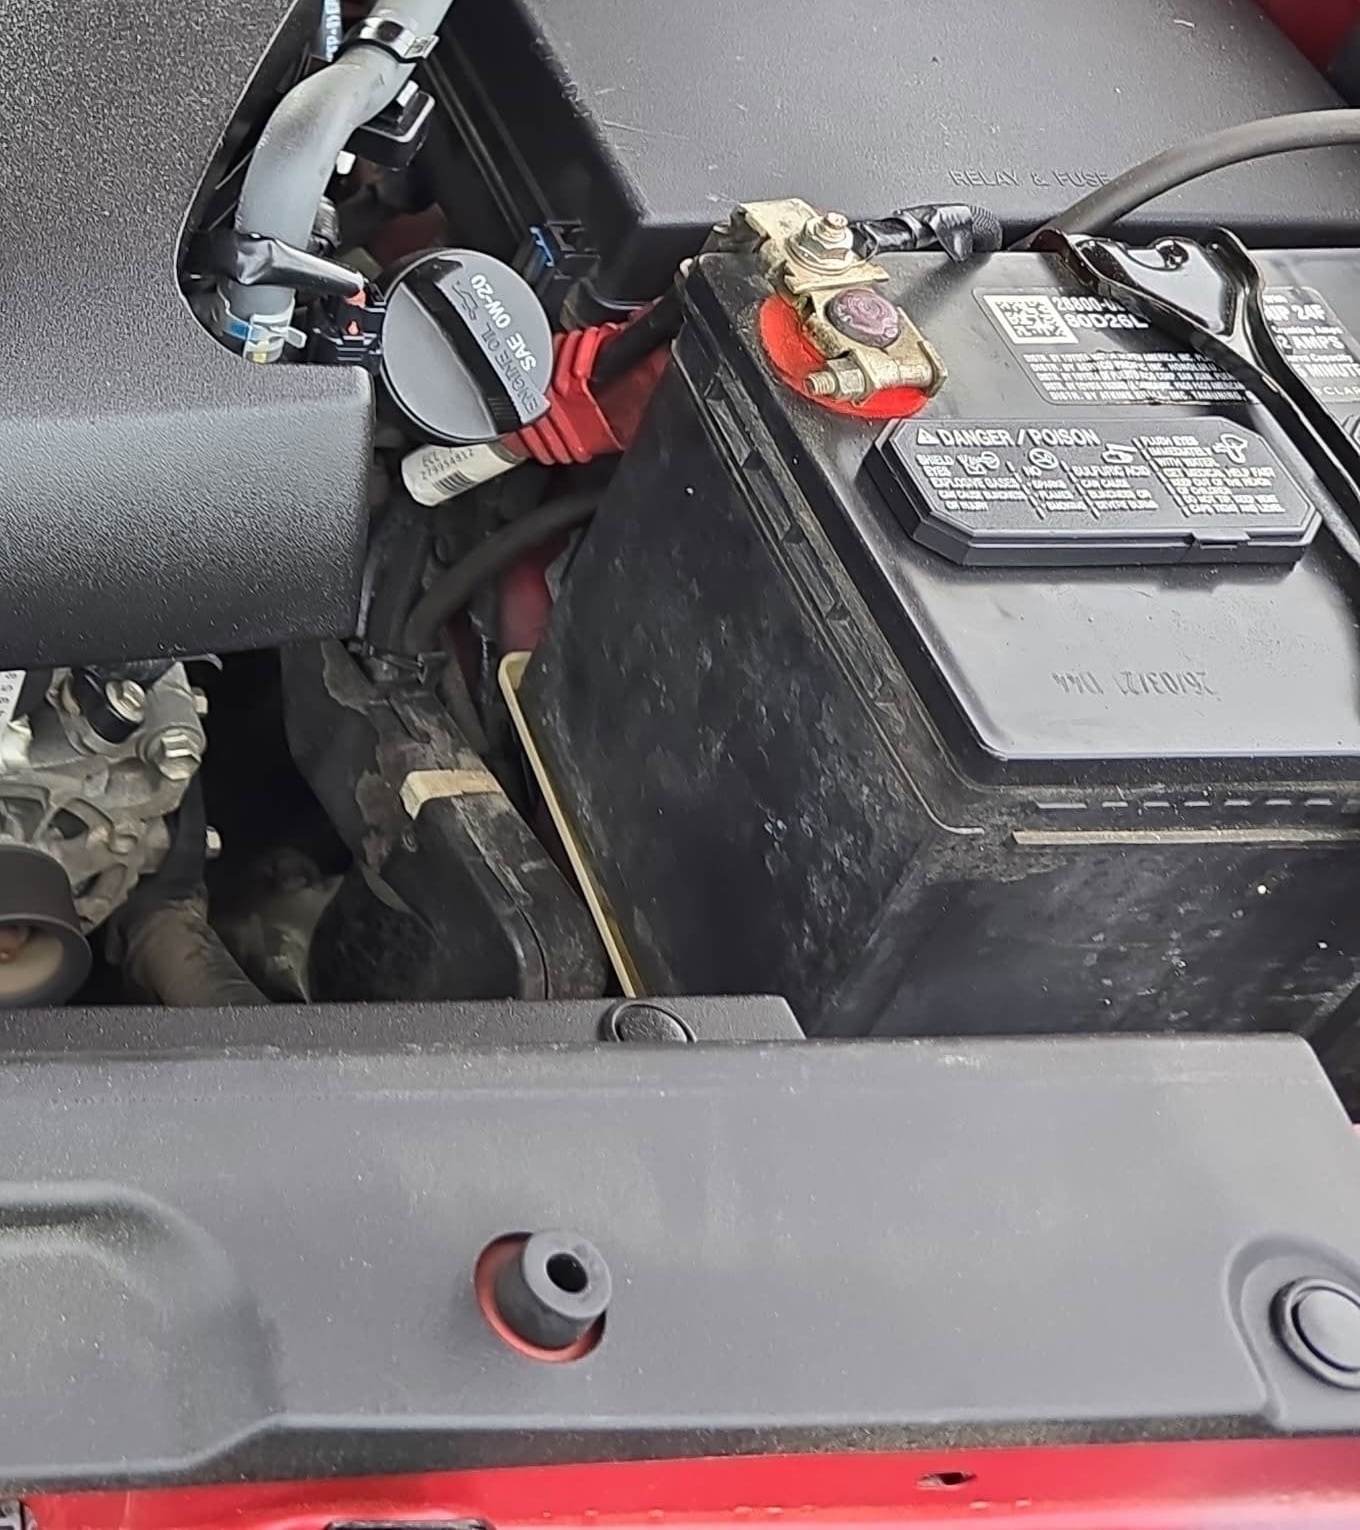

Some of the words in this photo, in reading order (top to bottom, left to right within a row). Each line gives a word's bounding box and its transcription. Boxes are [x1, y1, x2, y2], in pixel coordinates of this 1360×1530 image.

[949, 170, 1020, 187] RELAY
[1031, 172, 1050, 187] &
[1064, 313, 1150, 329] 80D26L
[1291, 304, 1326, 321] 24F
[481, 323, 500, 351] OIL
[1290, 334, 1344, 350] AMPS
[506, 333, 537, 372] SAE
[494, 353, 539, 413] ENGINE
[936, 428, 1015, 447] DANGER
[1027, 428, 1102, 447] POISON
[916, 454, 954, 466] SHIELD
[1022, 465, 1042, 477] NO
